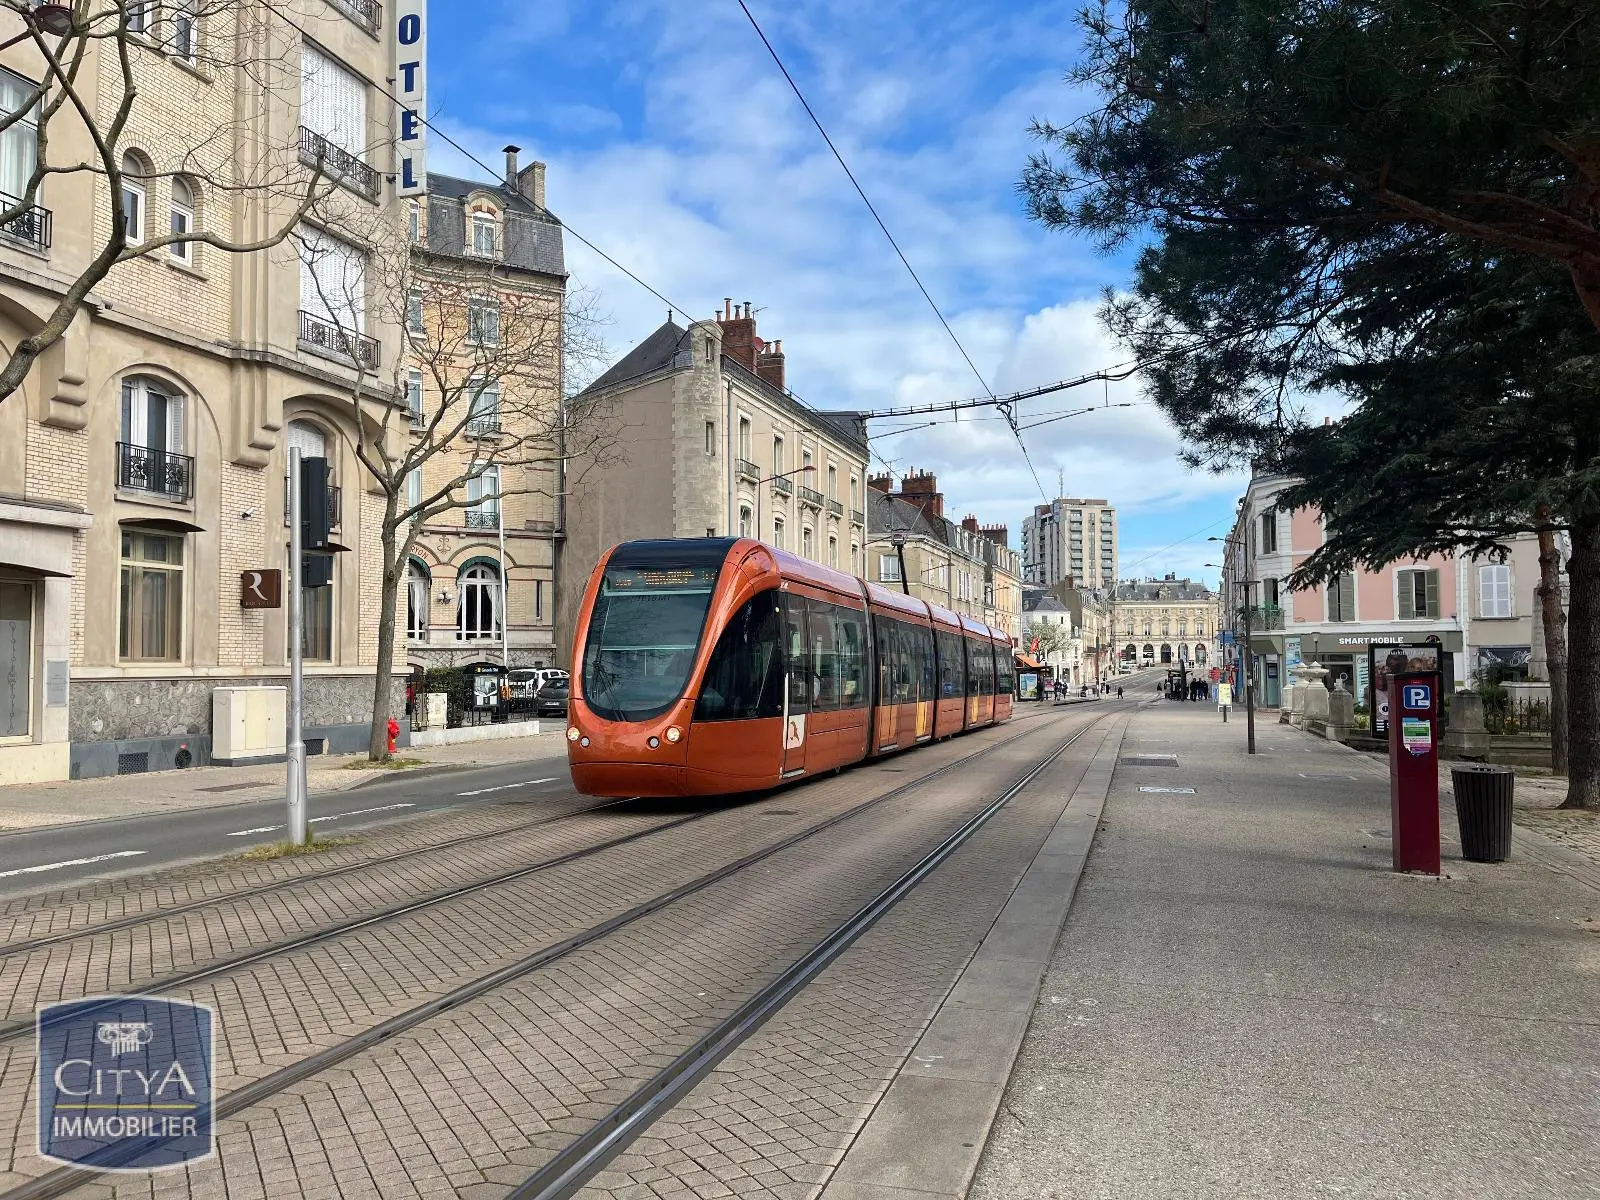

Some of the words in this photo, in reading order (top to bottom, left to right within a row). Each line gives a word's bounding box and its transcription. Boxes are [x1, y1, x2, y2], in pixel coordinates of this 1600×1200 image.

[1338, 637, 1369, 645] SMART
[1370, 636, 1404, 644] MOBILE
[1410, 688, 1425, 706] P
